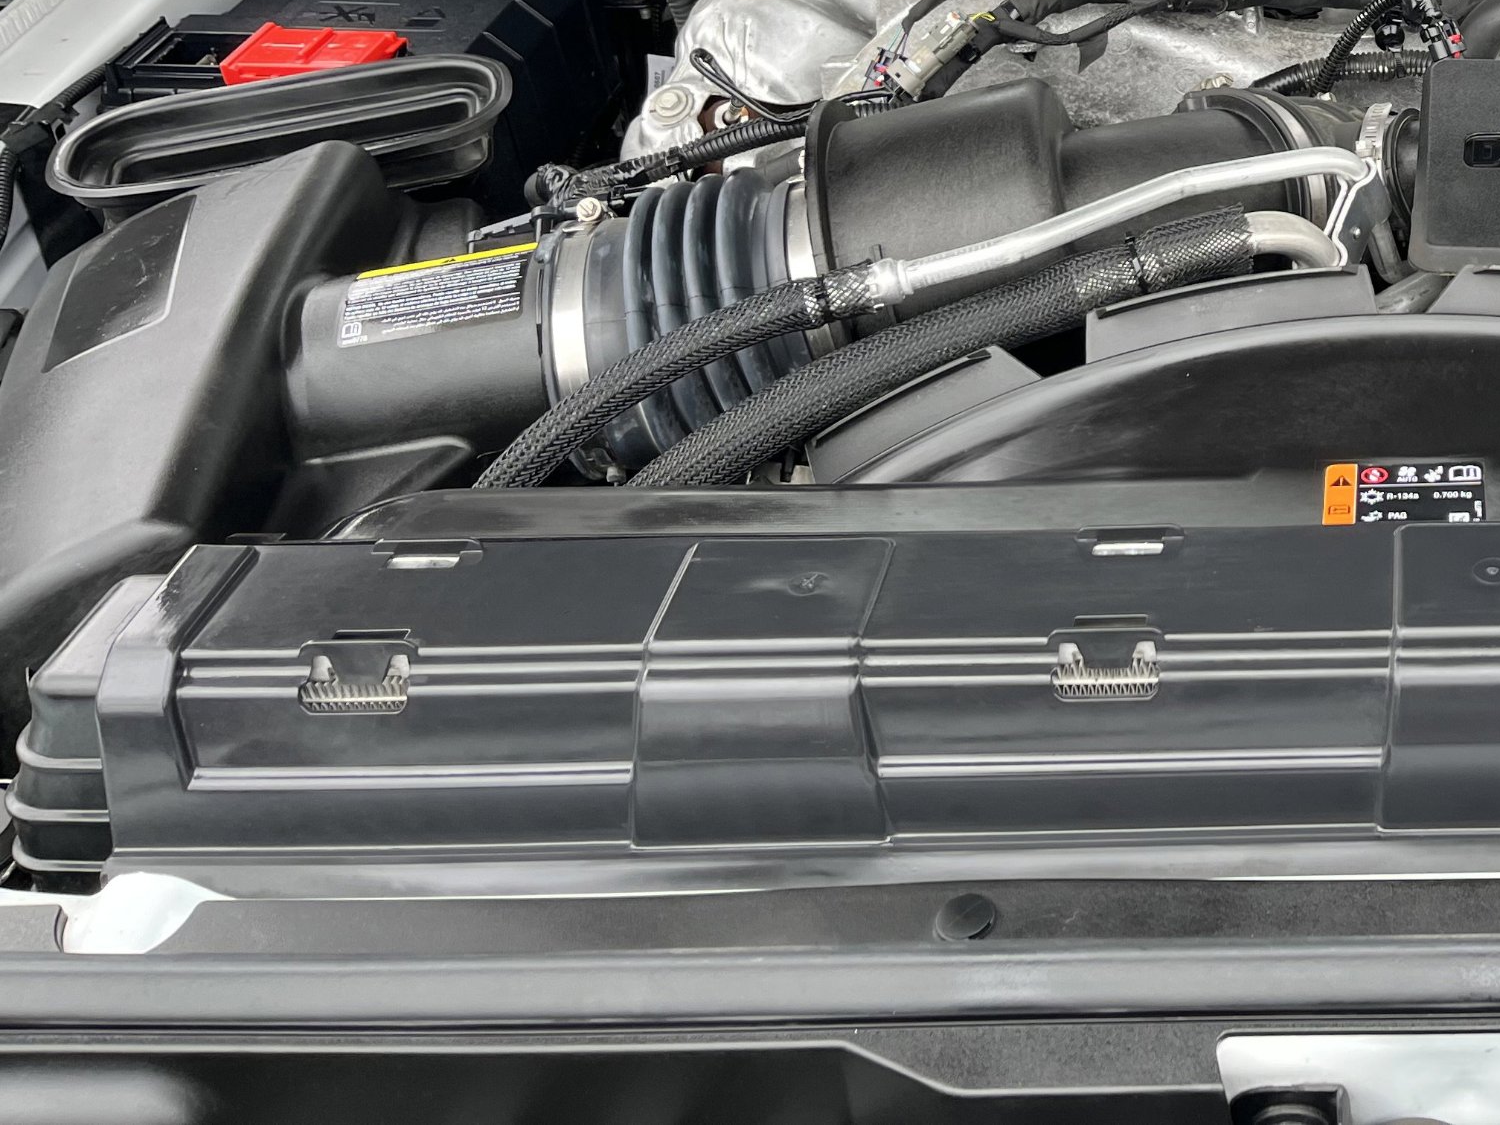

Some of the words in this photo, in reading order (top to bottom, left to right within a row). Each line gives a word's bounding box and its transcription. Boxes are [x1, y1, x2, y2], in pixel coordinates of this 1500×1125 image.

[1386, 492, 1420, 501] R-134a
[1433, 490, 1459, 500] 0.700
[1460, 490, 1473, 500] kg
[1387, 511, 1408, 521] PAG
